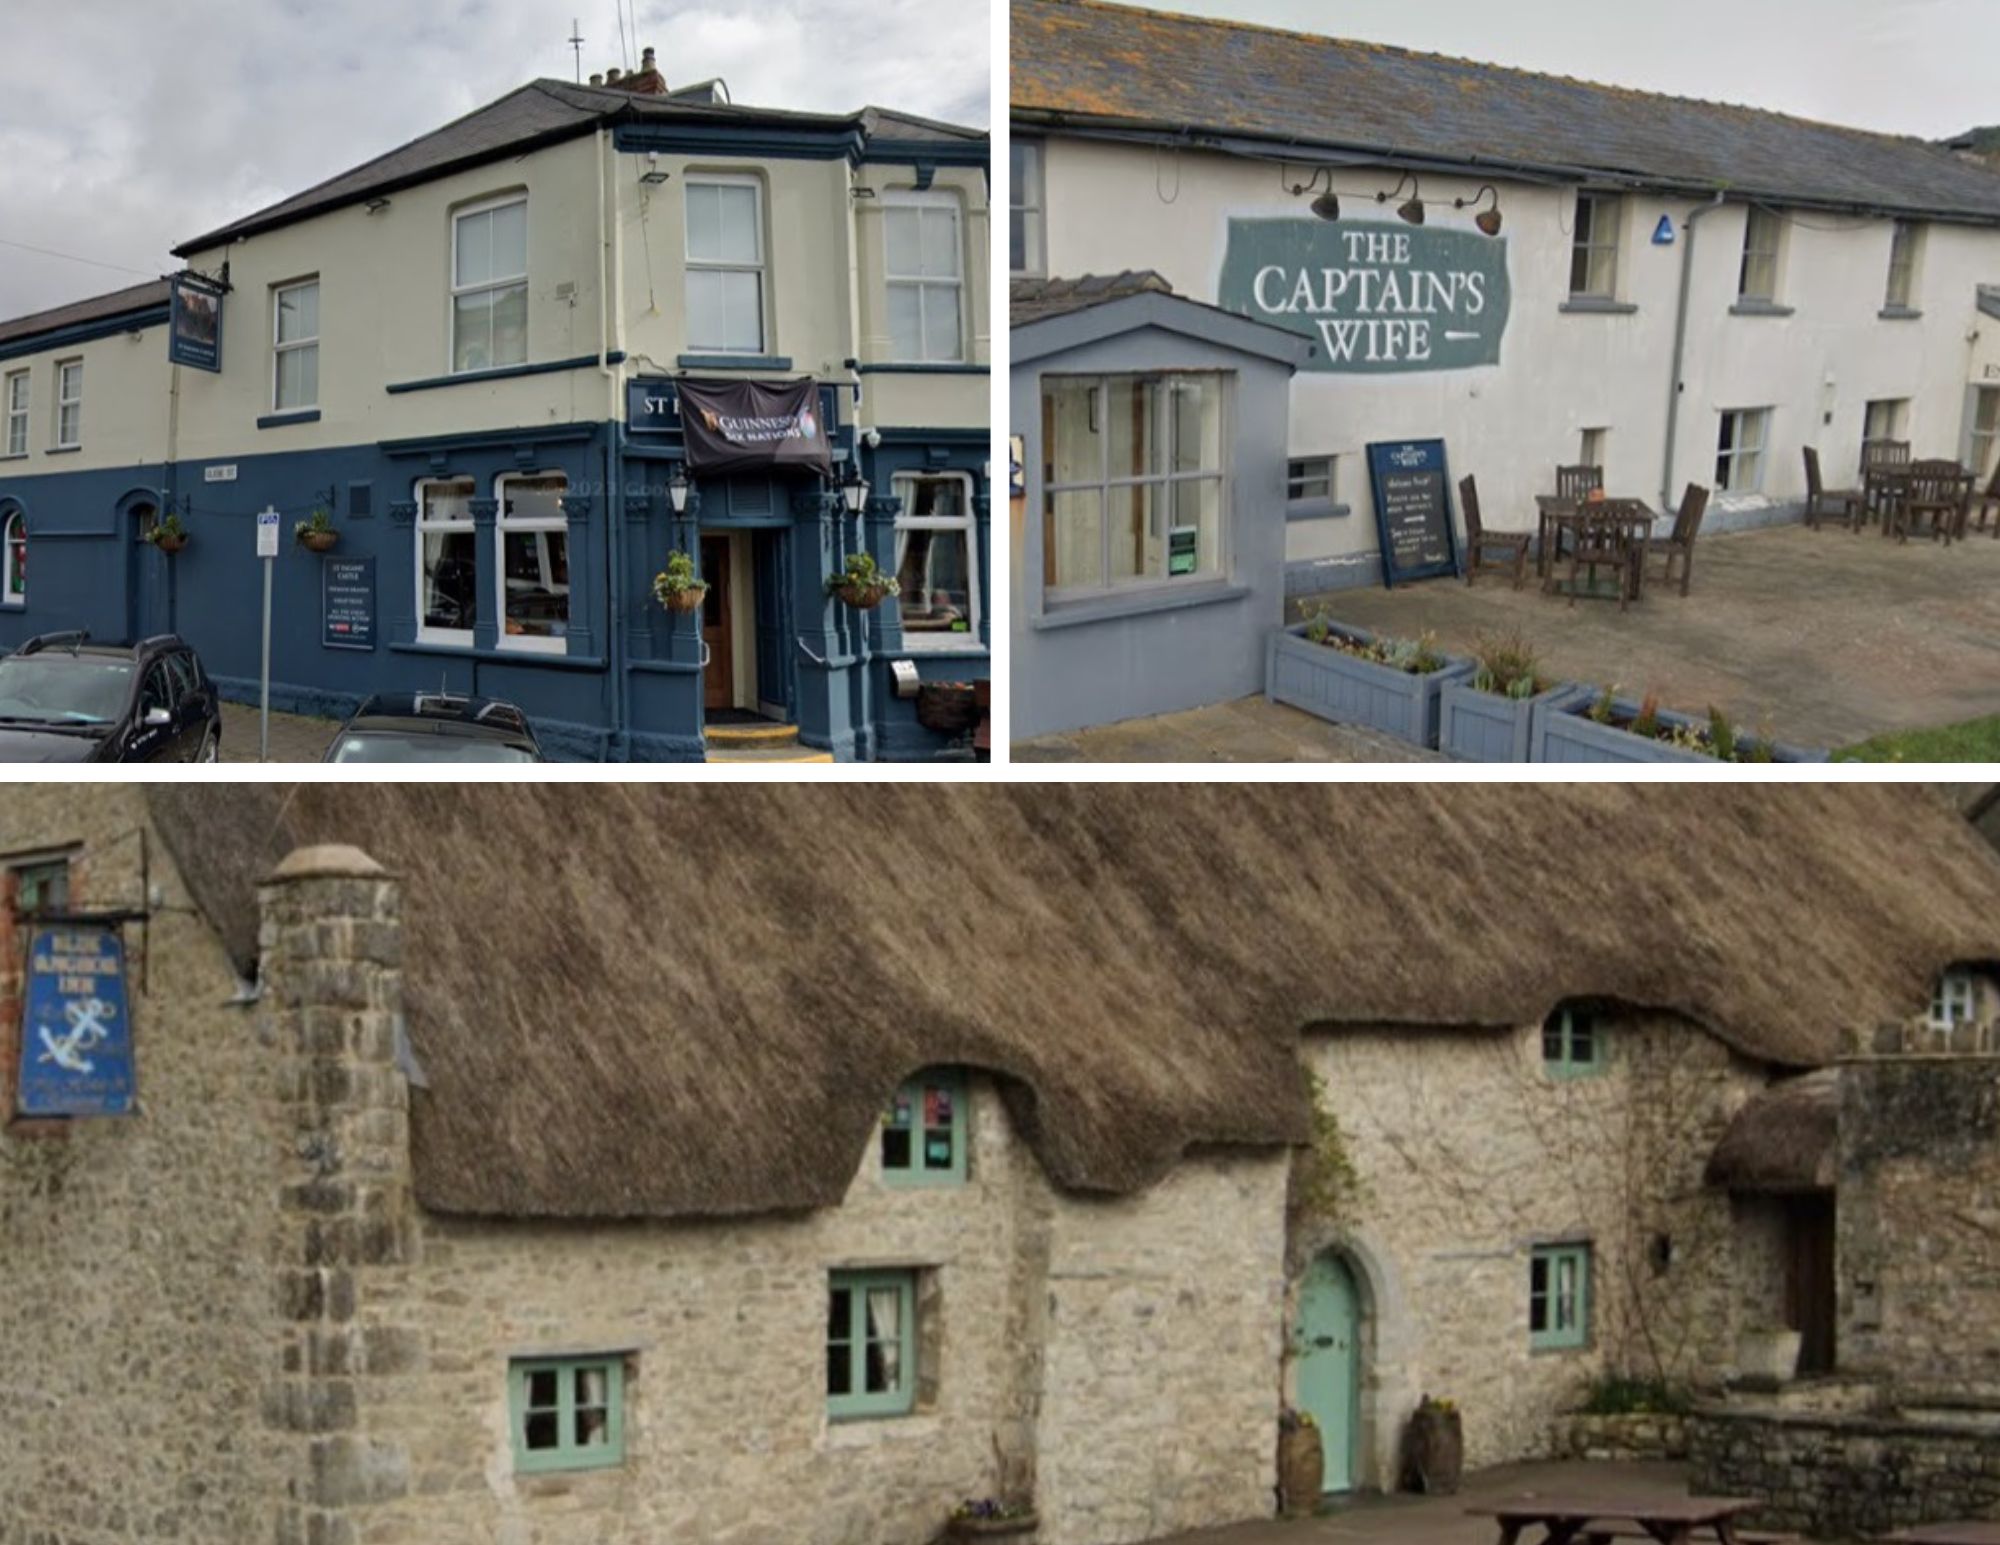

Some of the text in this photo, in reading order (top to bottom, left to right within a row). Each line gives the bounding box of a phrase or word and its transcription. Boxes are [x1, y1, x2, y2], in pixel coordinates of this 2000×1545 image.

[1342, 230, 1411, 265] THE
[1253, 265, 1486, 315] CAPTAIN'S
[1316, 319, 1432, 362] WIFE
[643, 395, 668, 414] ST
